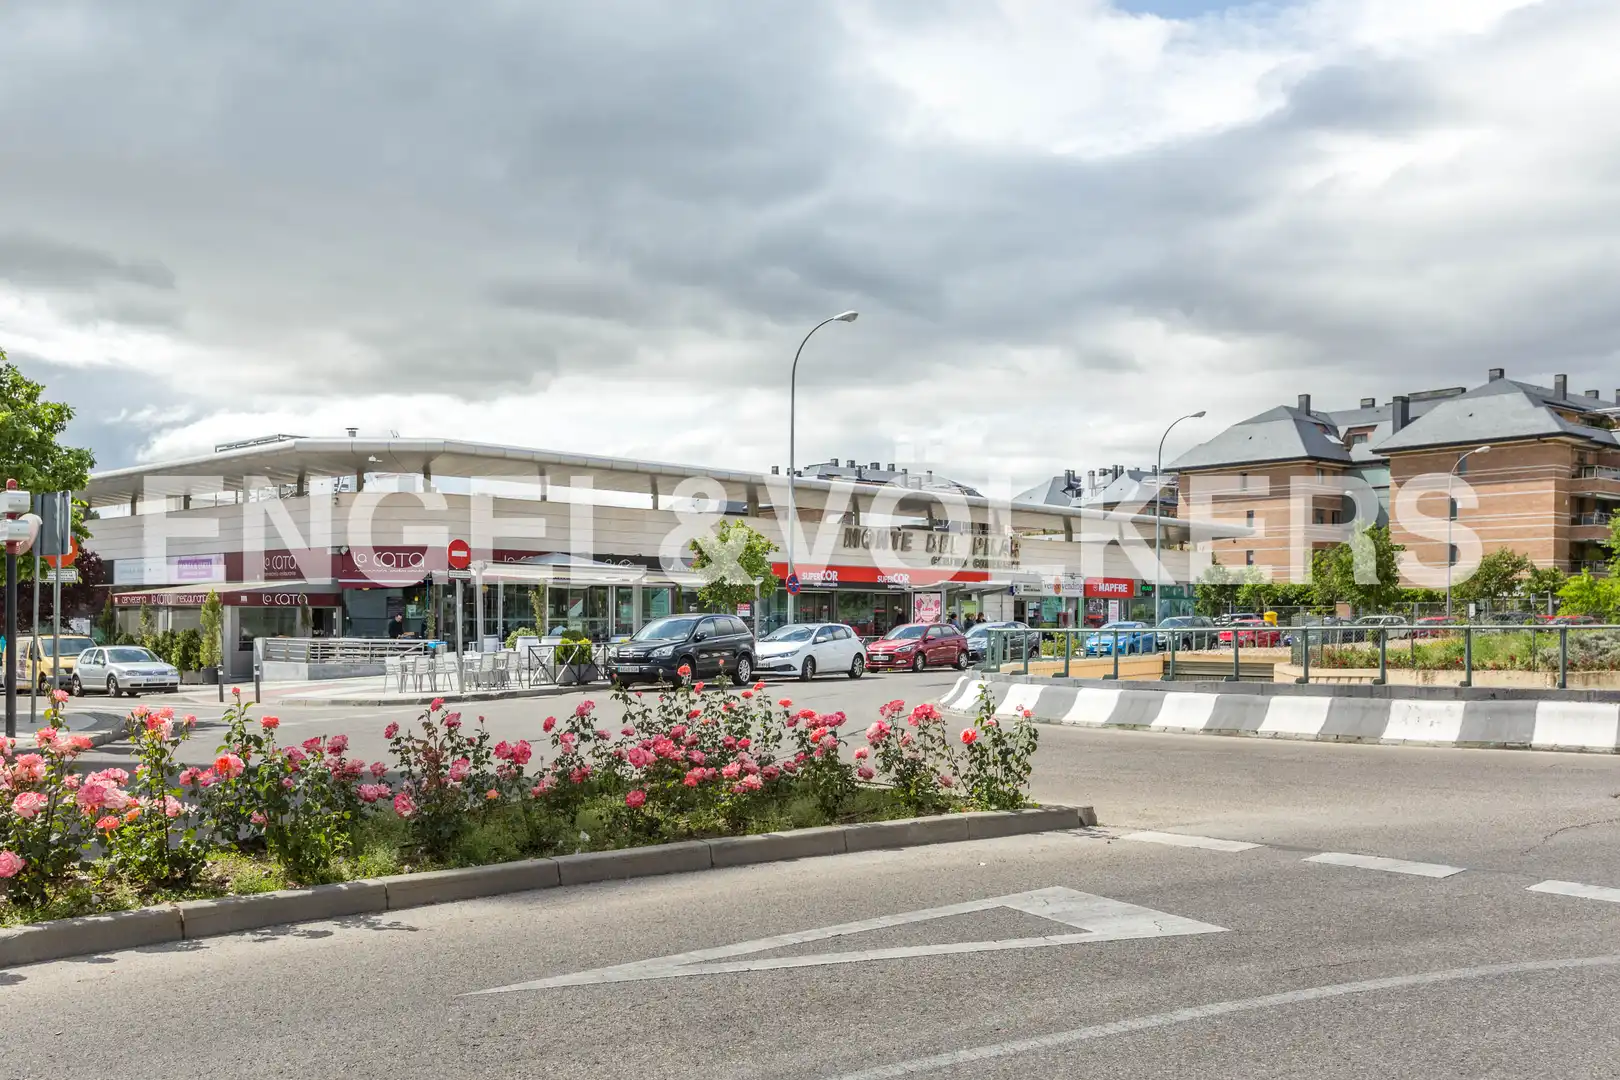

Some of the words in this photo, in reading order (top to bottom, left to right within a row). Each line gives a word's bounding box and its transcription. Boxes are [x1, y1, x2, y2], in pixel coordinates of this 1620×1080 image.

[844, 527, 913, 552] MONTE
[926, 533, 961, 554] DEL
[972, 534, 1021, 557] PILAR
[801, 570, 839, 581] SUPERCOR
[877, 573, 910, 584] SUPERCOR
[1098, 583, 1128, 593] MAPFRE
